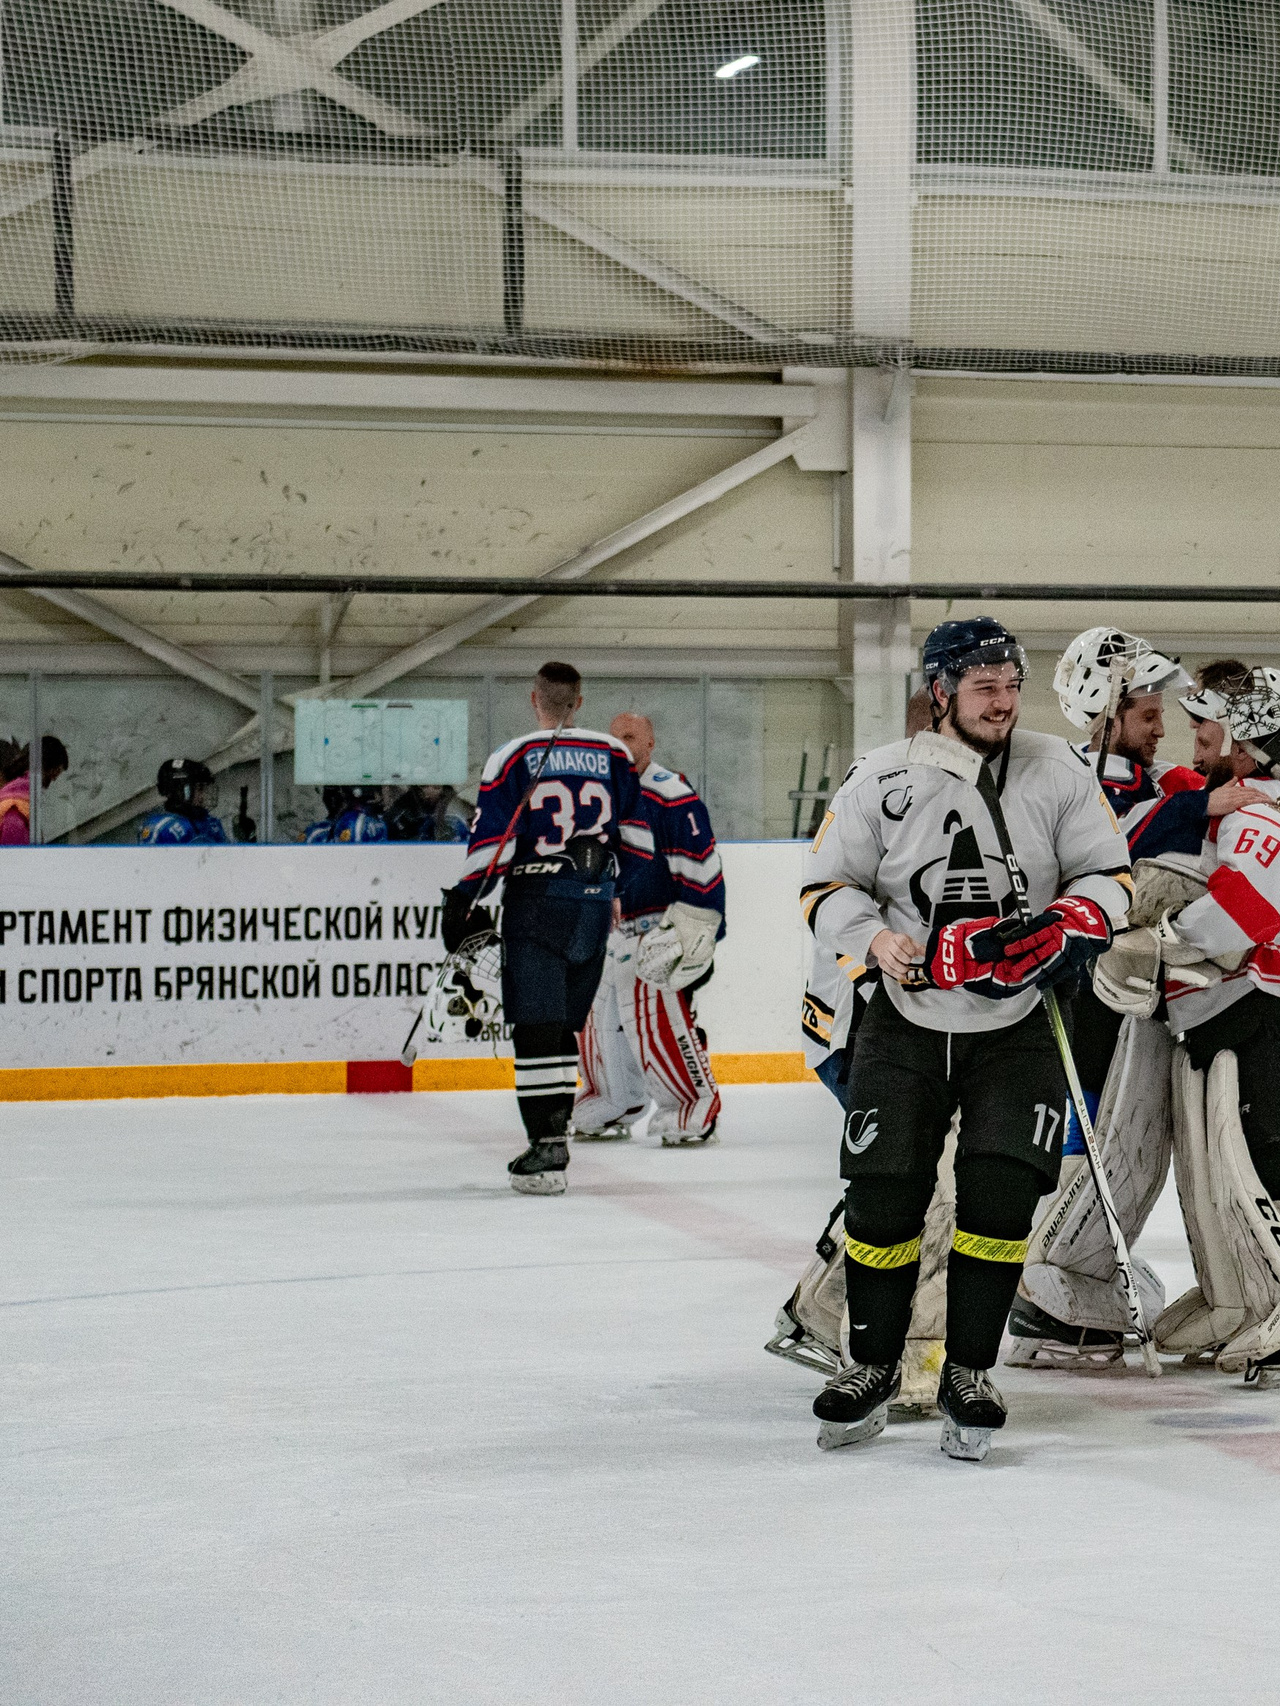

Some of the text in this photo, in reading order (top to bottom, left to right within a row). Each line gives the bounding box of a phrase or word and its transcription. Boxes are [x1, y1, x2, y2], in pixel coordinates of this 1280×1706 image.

[980, 637, 1006, 647] CCM
[926, 662, 939, 670] CCM
[530, 780, 612, 857] 32
[686, 812, 701, 837] 1
[513, 862, 564, 876] CCM
[164, 901, 383, 946] ФИЗИЧЕСКОЙ
[942, 924, 957, 983] CCM
[18, 967, 142, 1004] СПОРТА
[154, 959, 320, 1002] БРЯНСКОЙ
[677, 1034, 705, 1088] VAUGHN
[1032, 1103, 1061, 1153] 17
